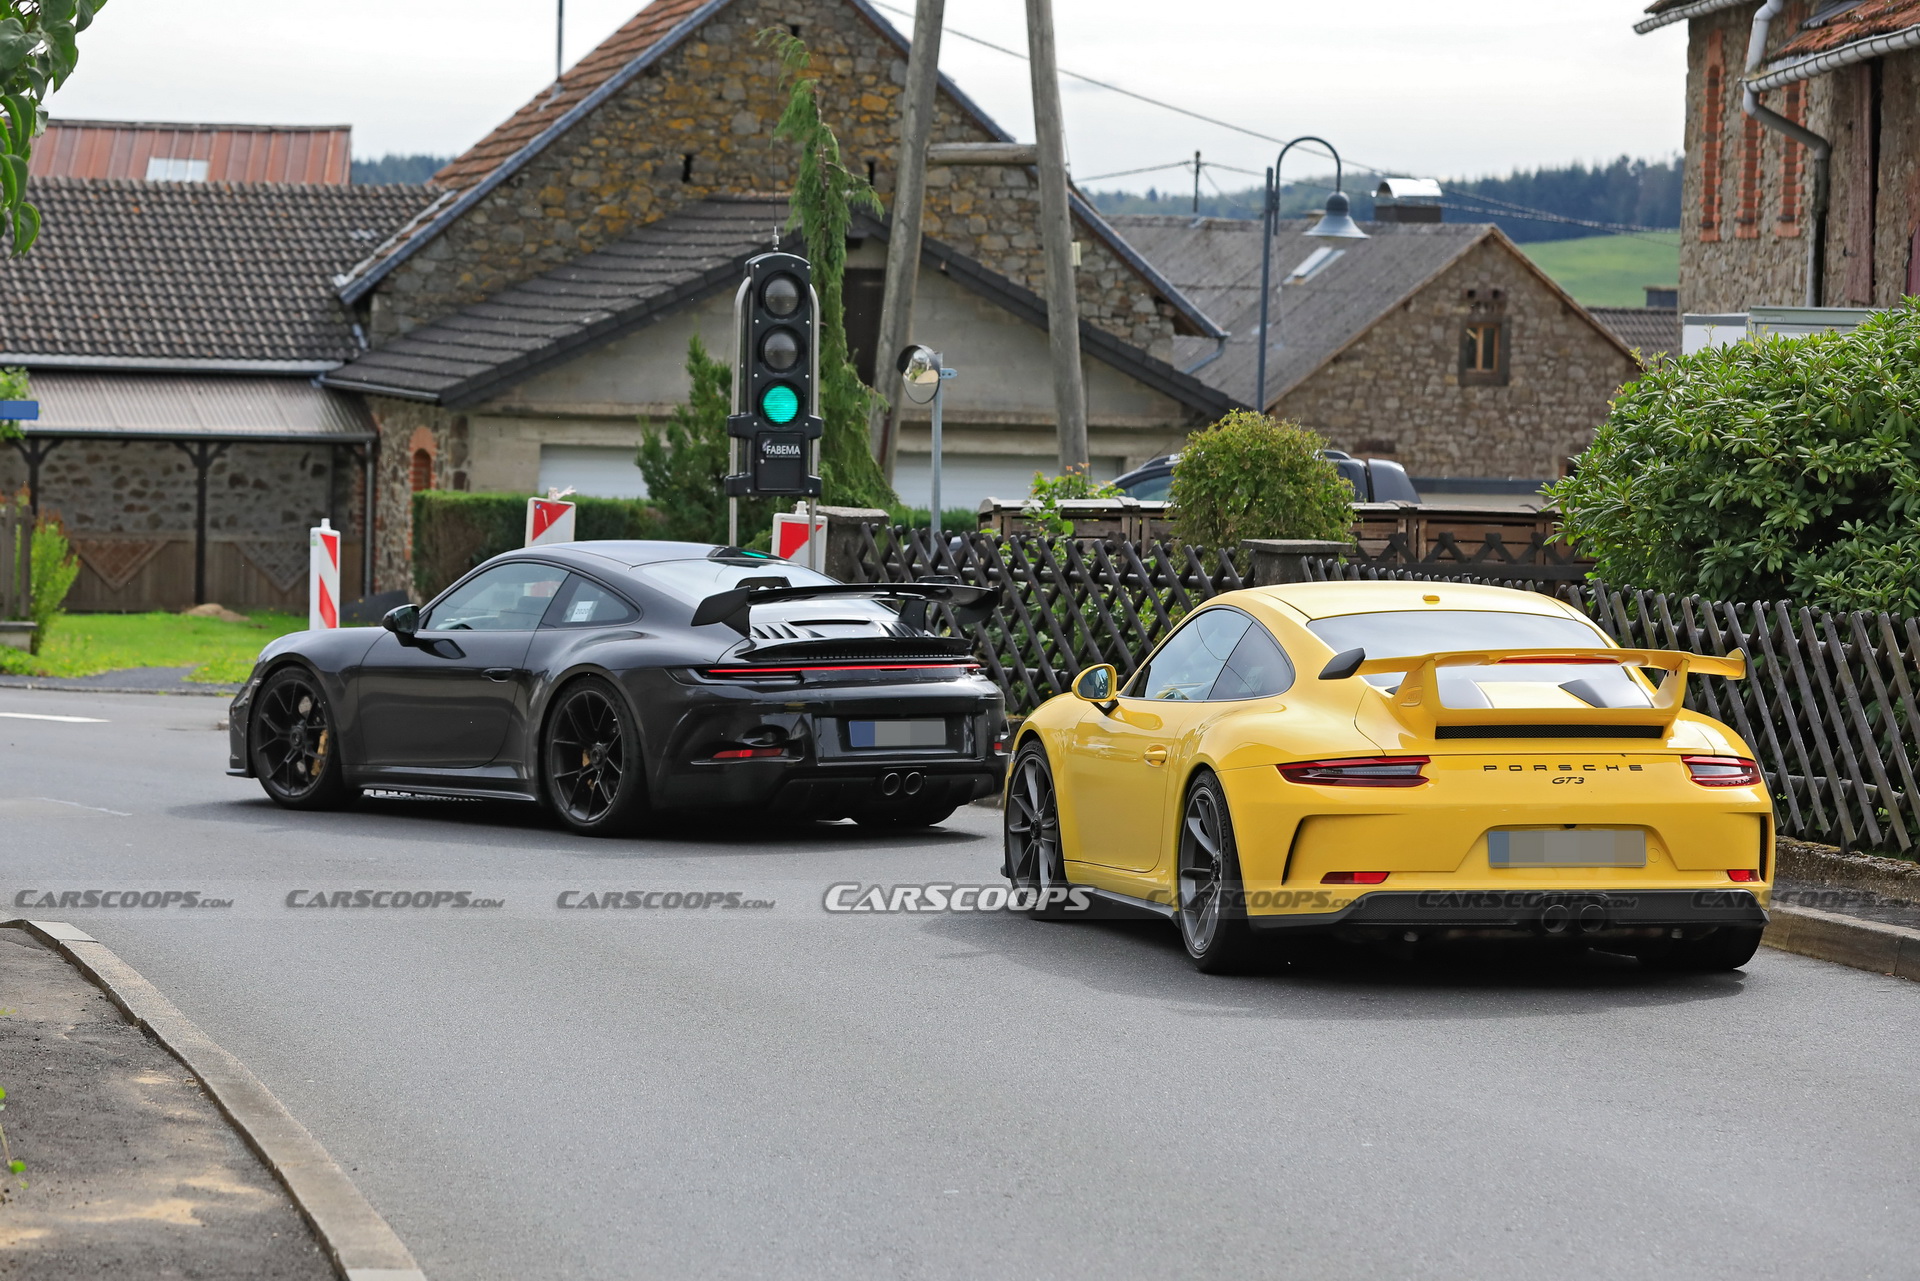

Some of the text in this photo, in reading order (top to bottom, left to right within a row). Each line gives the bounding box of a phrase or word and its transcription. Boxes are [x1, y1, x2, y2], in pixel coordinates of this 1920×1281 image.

[766, 445, 801, 455] FABEMA
[1483, 764, 1644, 772] PORSCHE
[1551, 776, 1585, 785] GT3
